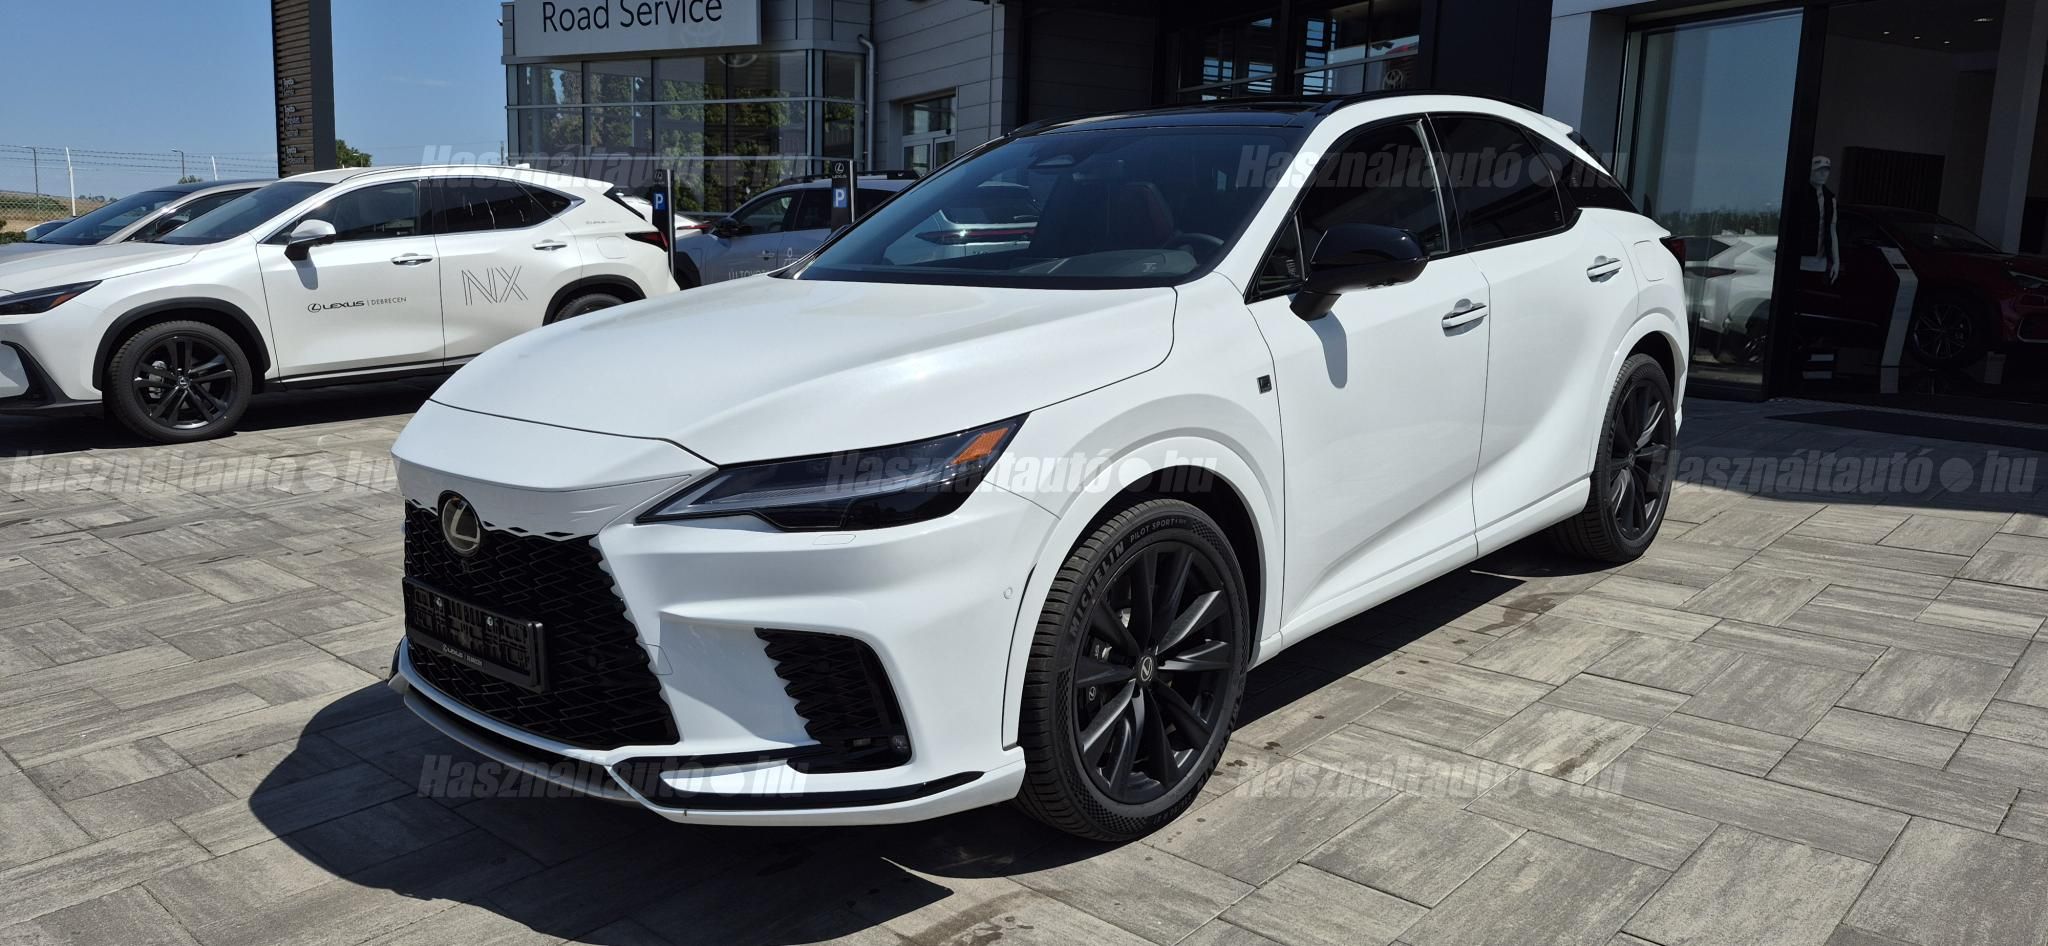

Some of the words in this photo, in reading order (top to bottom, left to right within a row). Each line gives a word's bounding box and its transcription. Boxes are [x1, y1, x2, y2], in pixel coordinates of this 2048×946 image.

[542, 0, 609, 32] Road
[619, 0, 722, 28] Service
[655, 193, 664, 209] P
[835, 189, 845, 207] P
[461, 266, 529, 305] NX
[322, 300, 365, 310] LEXUS
[371, 297, 407, 306] DEBRECEN
[1069, 540, 1125, 637] MICHELIN
[1129, 526, 1151, 544] PILOT
[1151, 518, 1175, 531] SPORT
